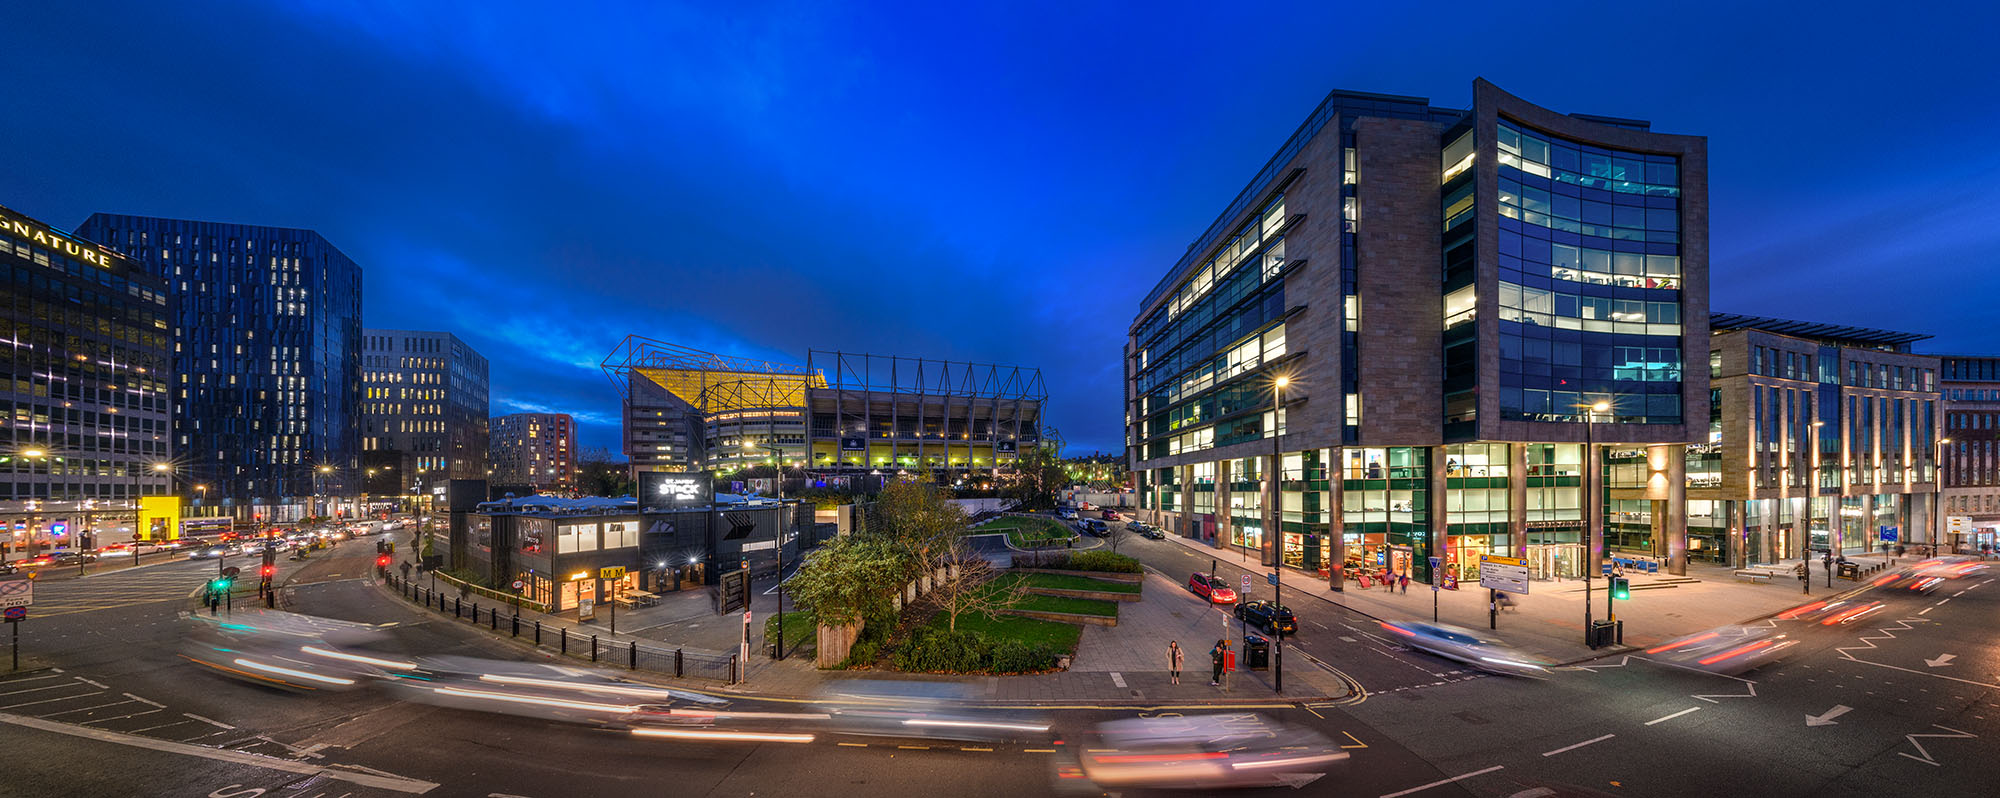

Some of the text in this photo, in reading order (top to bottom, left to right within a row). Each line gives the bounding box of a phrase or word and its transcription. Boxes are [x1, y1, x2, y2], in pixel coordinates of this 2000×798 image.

[0, 215, 111, 268] GNATURE
[603, 569, 612, 578] M
[615, 568, 624, 577] M
